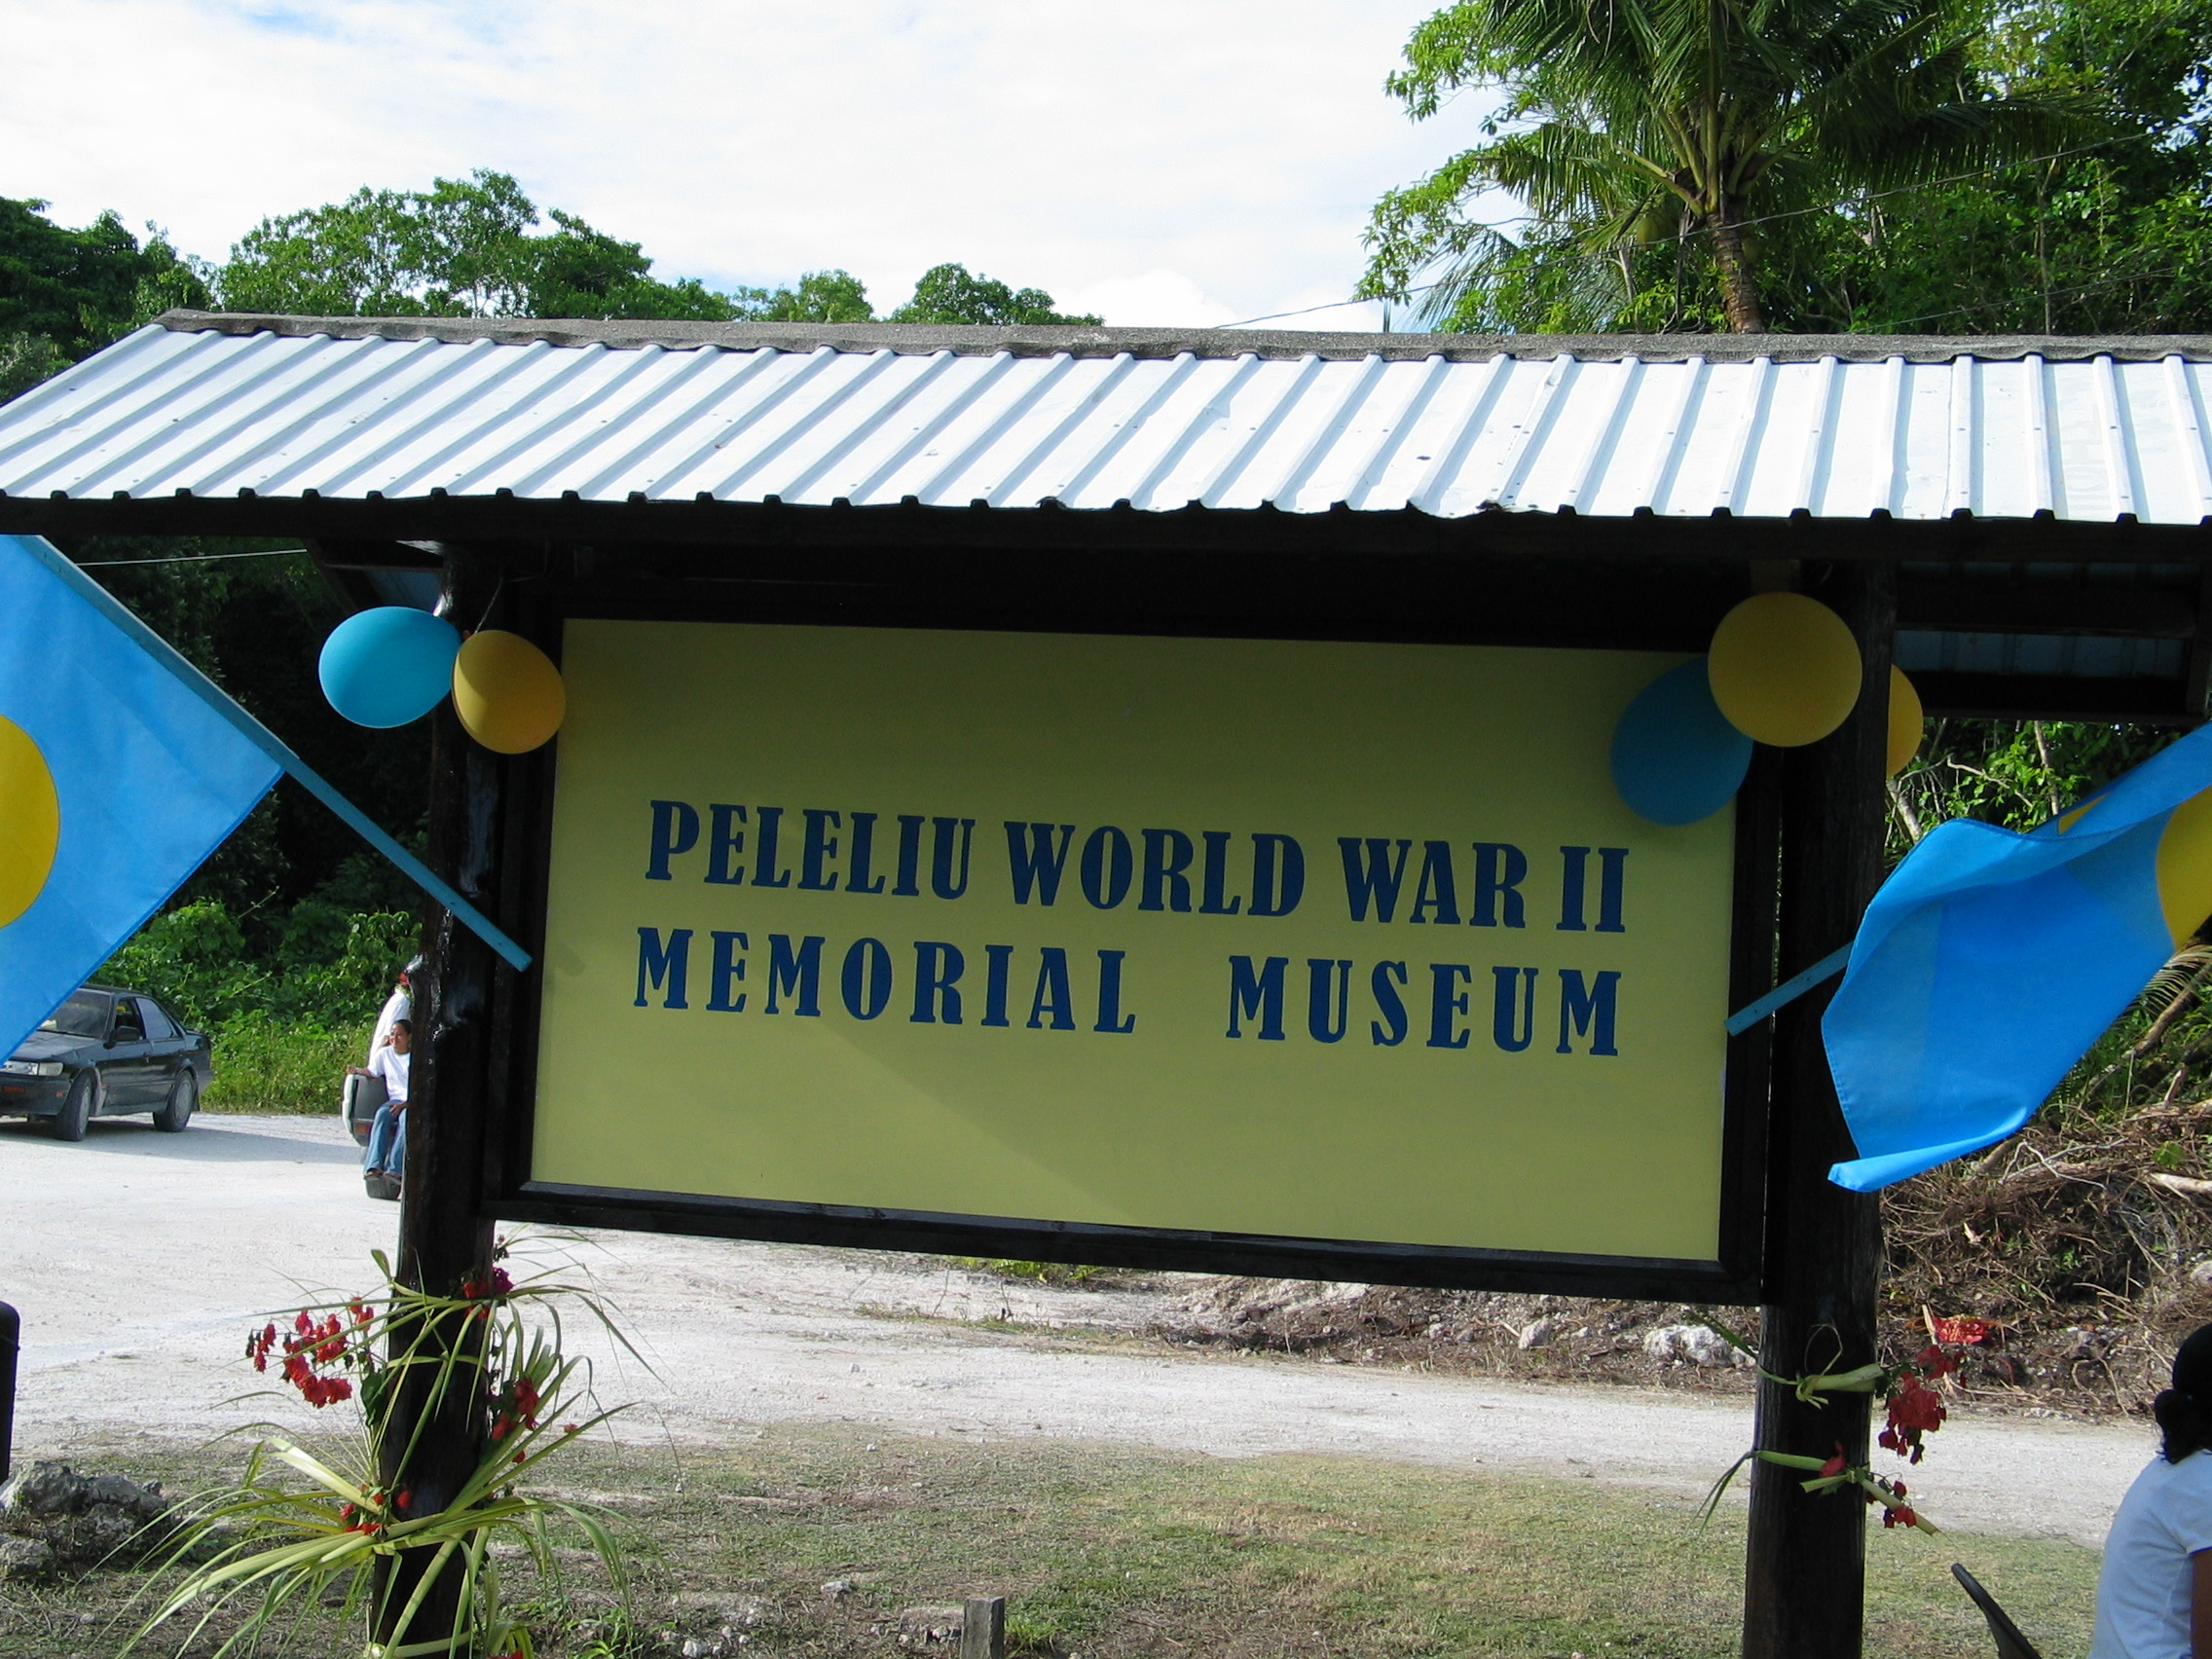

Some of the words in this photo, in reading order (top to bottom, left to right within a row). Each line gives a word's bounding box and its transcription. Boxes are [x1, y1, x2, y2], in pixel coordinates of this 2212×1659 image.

[645, 800, 976, 900] PELELIU
[1004, 822, 1306, 916] WORLD
[1338, 837, 1529, 928] WAR
[1557, 846, 1630, 933] II
[634, 927, 1136, 1033] MEMORIAL
[1226, 955, 1622, 1056] MUSEUM
